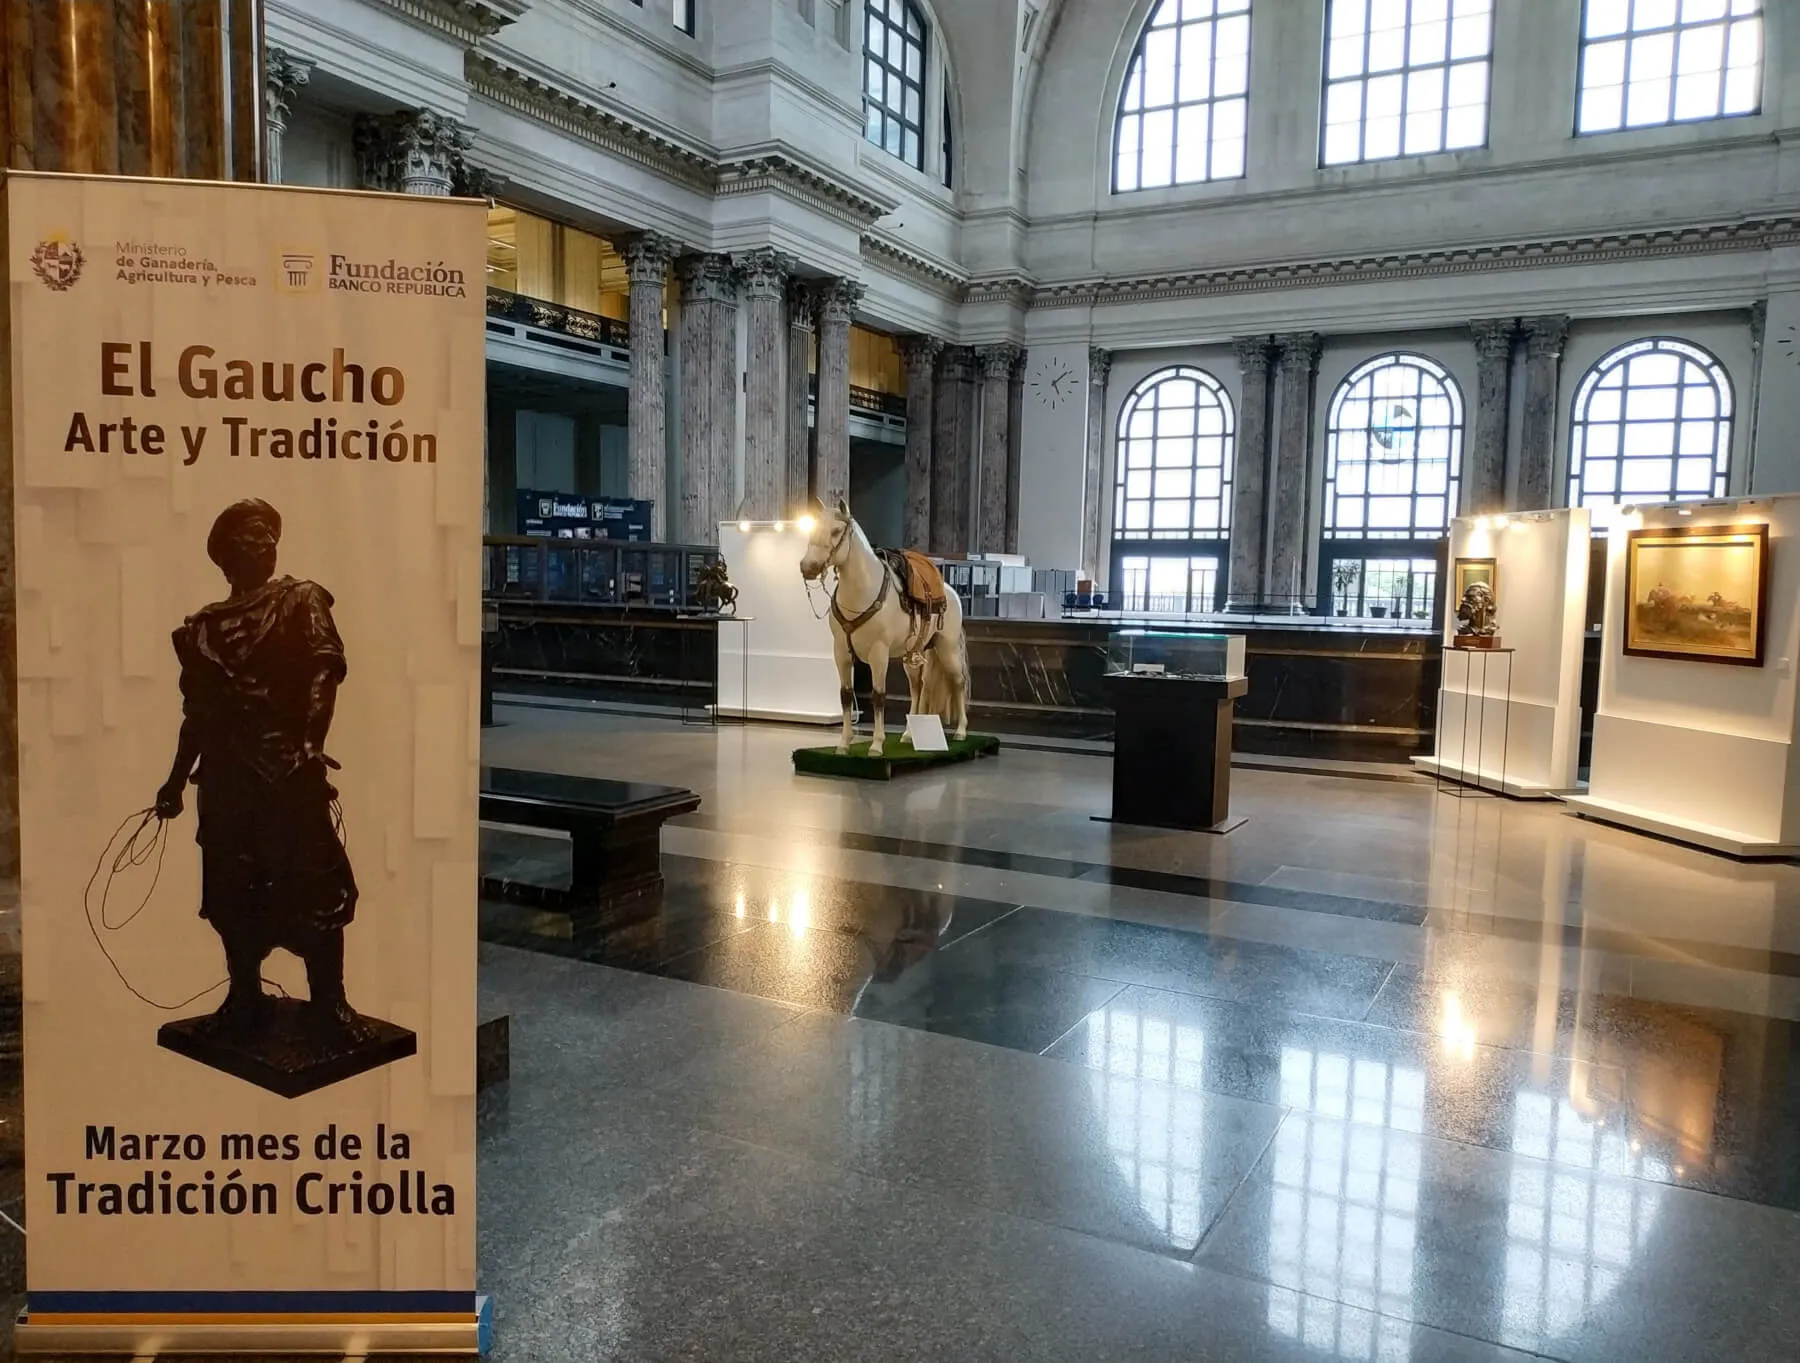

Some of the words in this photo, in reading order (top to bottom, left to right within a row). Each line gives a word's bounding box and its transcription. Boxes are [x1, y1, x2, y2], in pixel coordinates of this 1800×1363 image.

[116, 241, 188, 256] Ministerio
[116, 256, 135, 267] de
[116, 269, 198, 285] Agricultura
[202, 275, 210, 287] y
[215, 273, 257, 286] Pesca
[329, 255, 465, 284] Fundación
[328, 278, 382, 294] BANCO
[101, 341, 157, 398] El
[178, 344, 405, 407] Gaucho
[64, 412, 166, 456] Arte
[180, 425, 208, 467] y
[222, 416, 437, 464] Tradición
[85, 1124, 207, 1161] Marzo
[220, 1133, 301, 1161] mes
[313, 1123, 363, 1161] de
[376, 1122, 411, 1161] la
[46, 1168, 278, 1216] Tradición
[295, 1169, 455, 1216] Criolla
